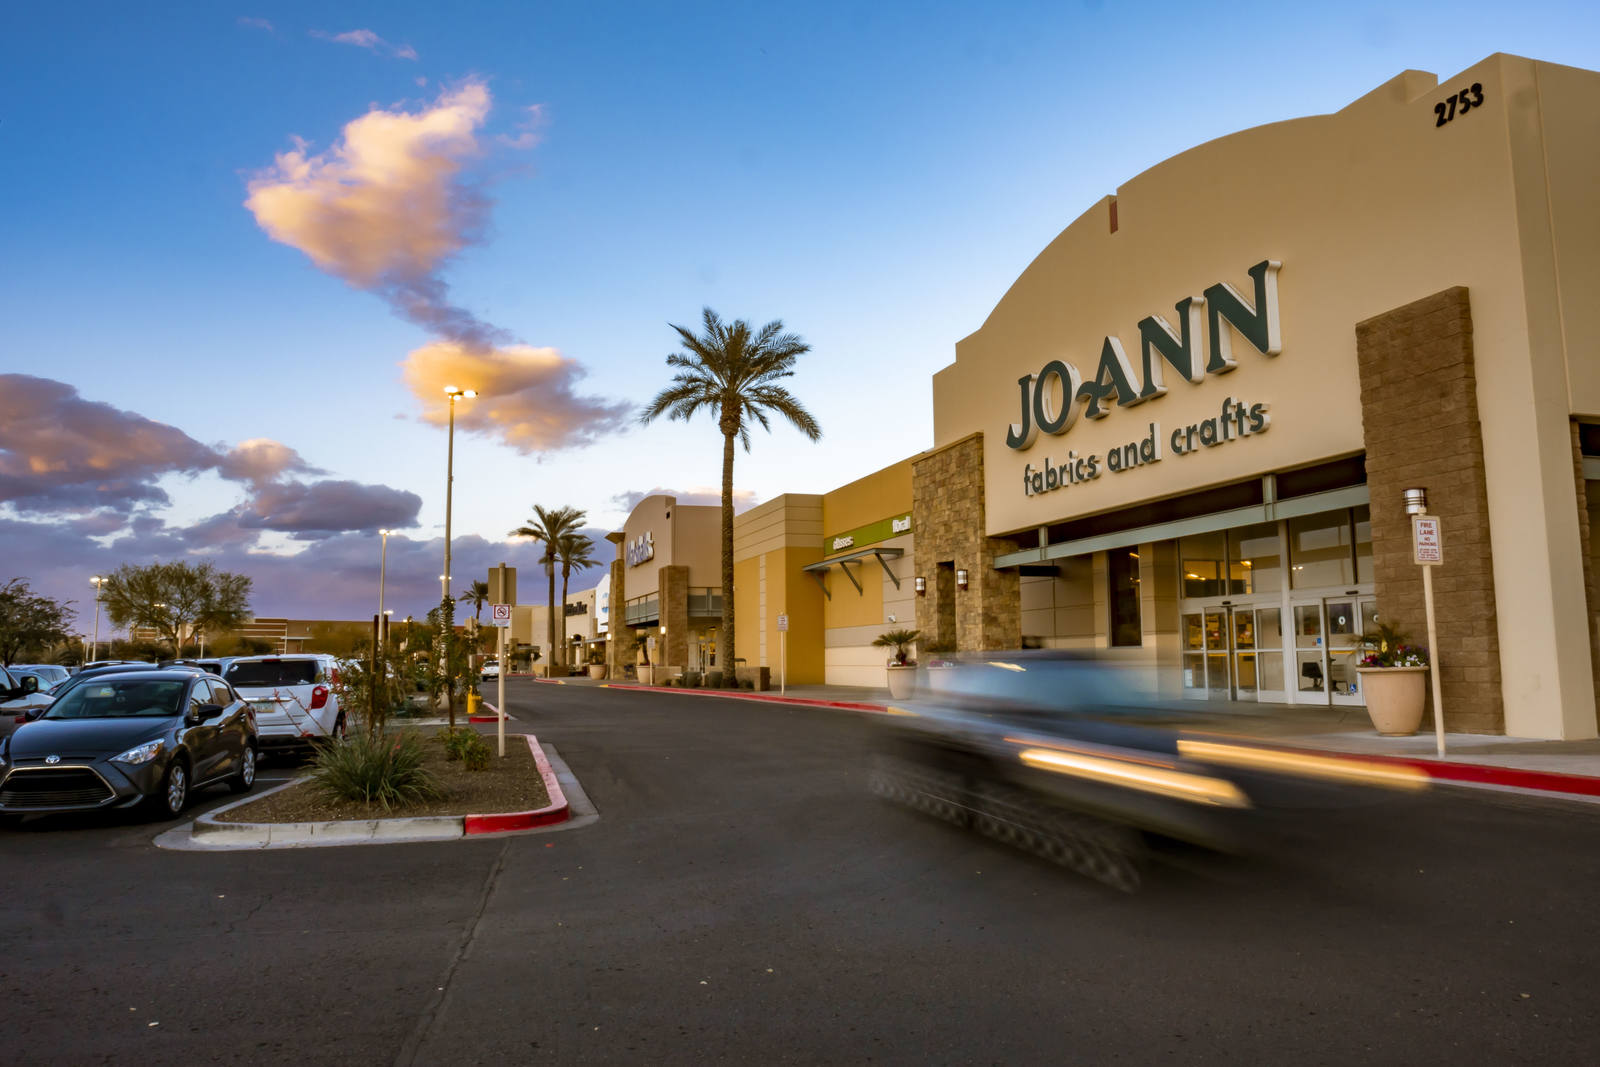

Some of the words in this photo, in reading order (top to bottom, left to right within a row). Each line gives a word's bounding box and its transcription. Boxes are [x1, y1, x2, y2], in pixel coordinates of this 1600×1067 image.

[1434, 82, 1484, 128] 2753
[1024, 451, 1102, 497] fabrics
[1107, 422, 1162, 472] and
[1171, 396, 1271, 455] crafts
